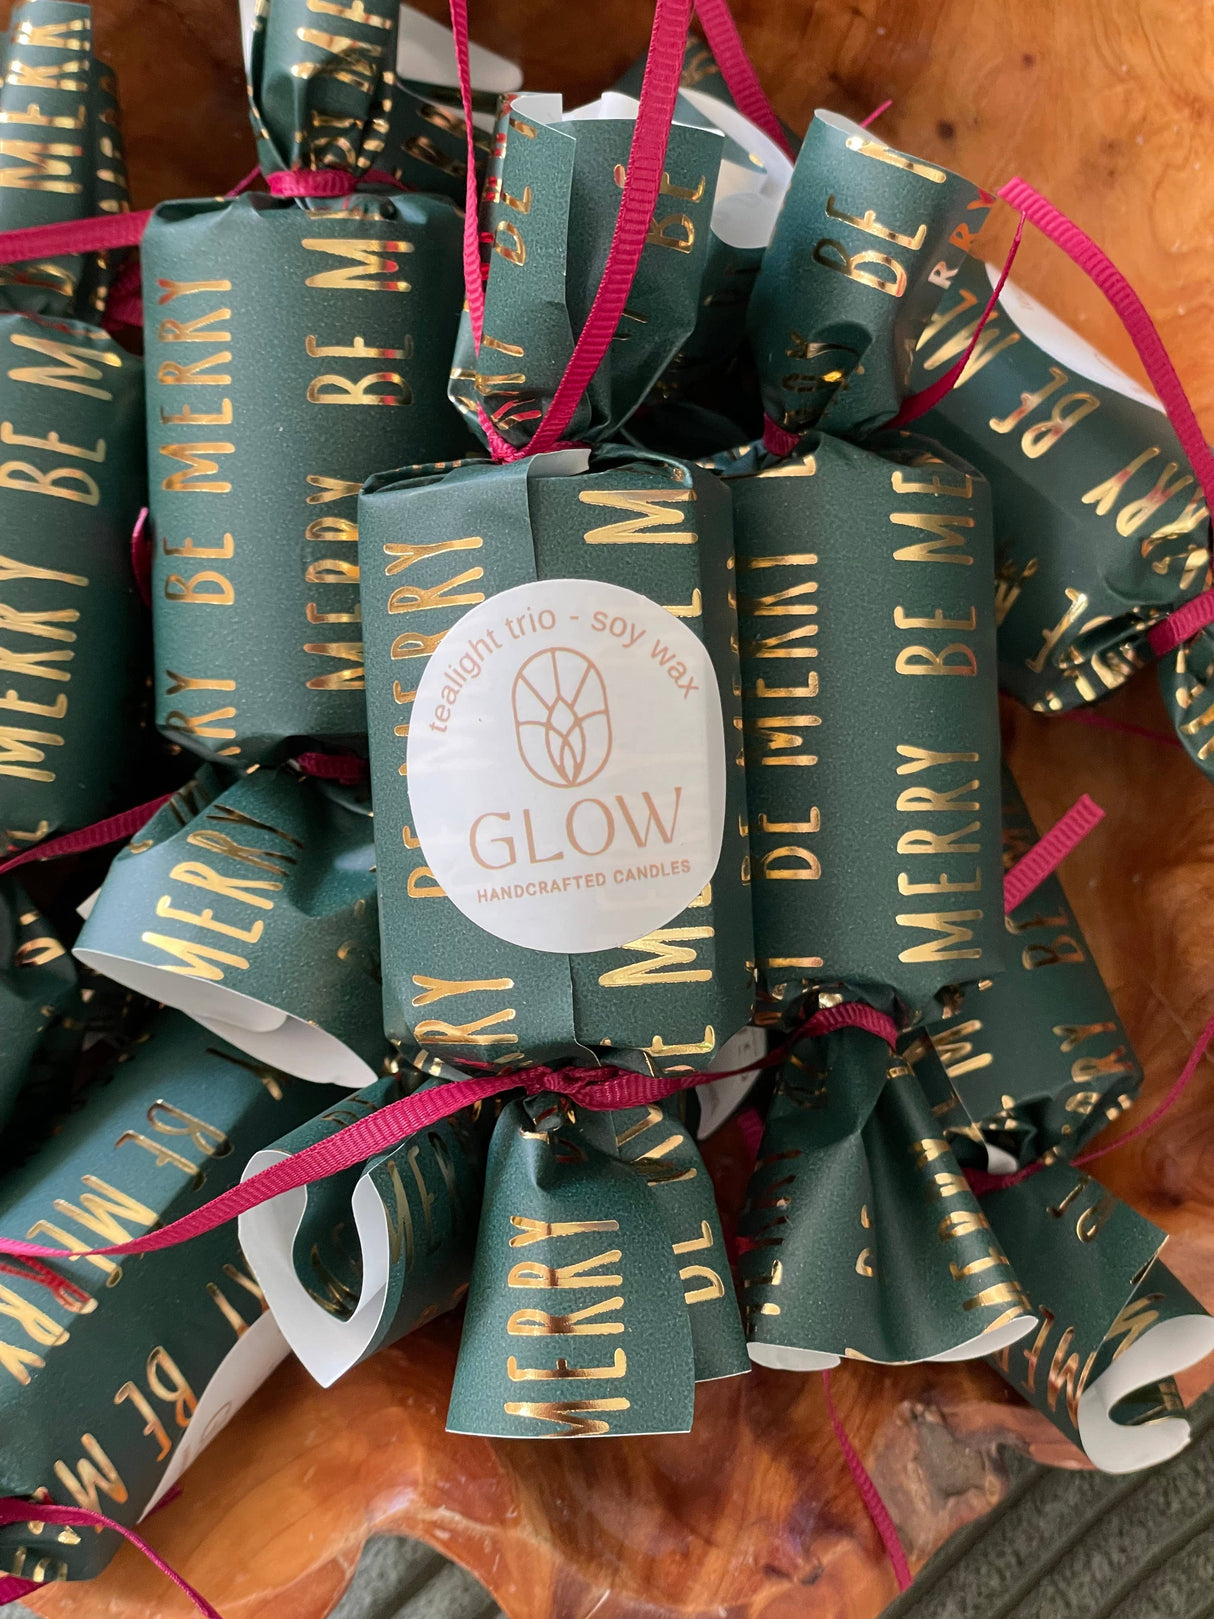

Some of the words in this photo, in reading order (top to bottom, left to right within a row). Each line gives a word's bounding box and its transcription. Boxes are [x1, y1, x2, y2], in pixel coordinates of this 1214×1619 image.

[813, 194, 927, 298] BE
[157, 277, 236, 493] MERRY
[305, 334, 413, 405] BE
[988, 366, 1100, 459] BE
[0, 420, 106, 508] BE
[163, 532, 236, 606] BE
[430, 628, 504, 734] tealight
[504, 606, 556, 640] trio
[590, 610, 647, 649] soy
[649, 639, 700, 700] wax
[893, 605, 977, 676] BE
[469, 786, 682, 871] GLOW
[895, 745, 984, 964] MERRY
[141, 804, 305, 981] MERRY
[476, 872, 607, 904] HANDCRAFTED
[612, 858, 692, 885] CANDLES
[114, 1098, 235, 1191] BE
[503, 1215, 630, 1437] MERRY
